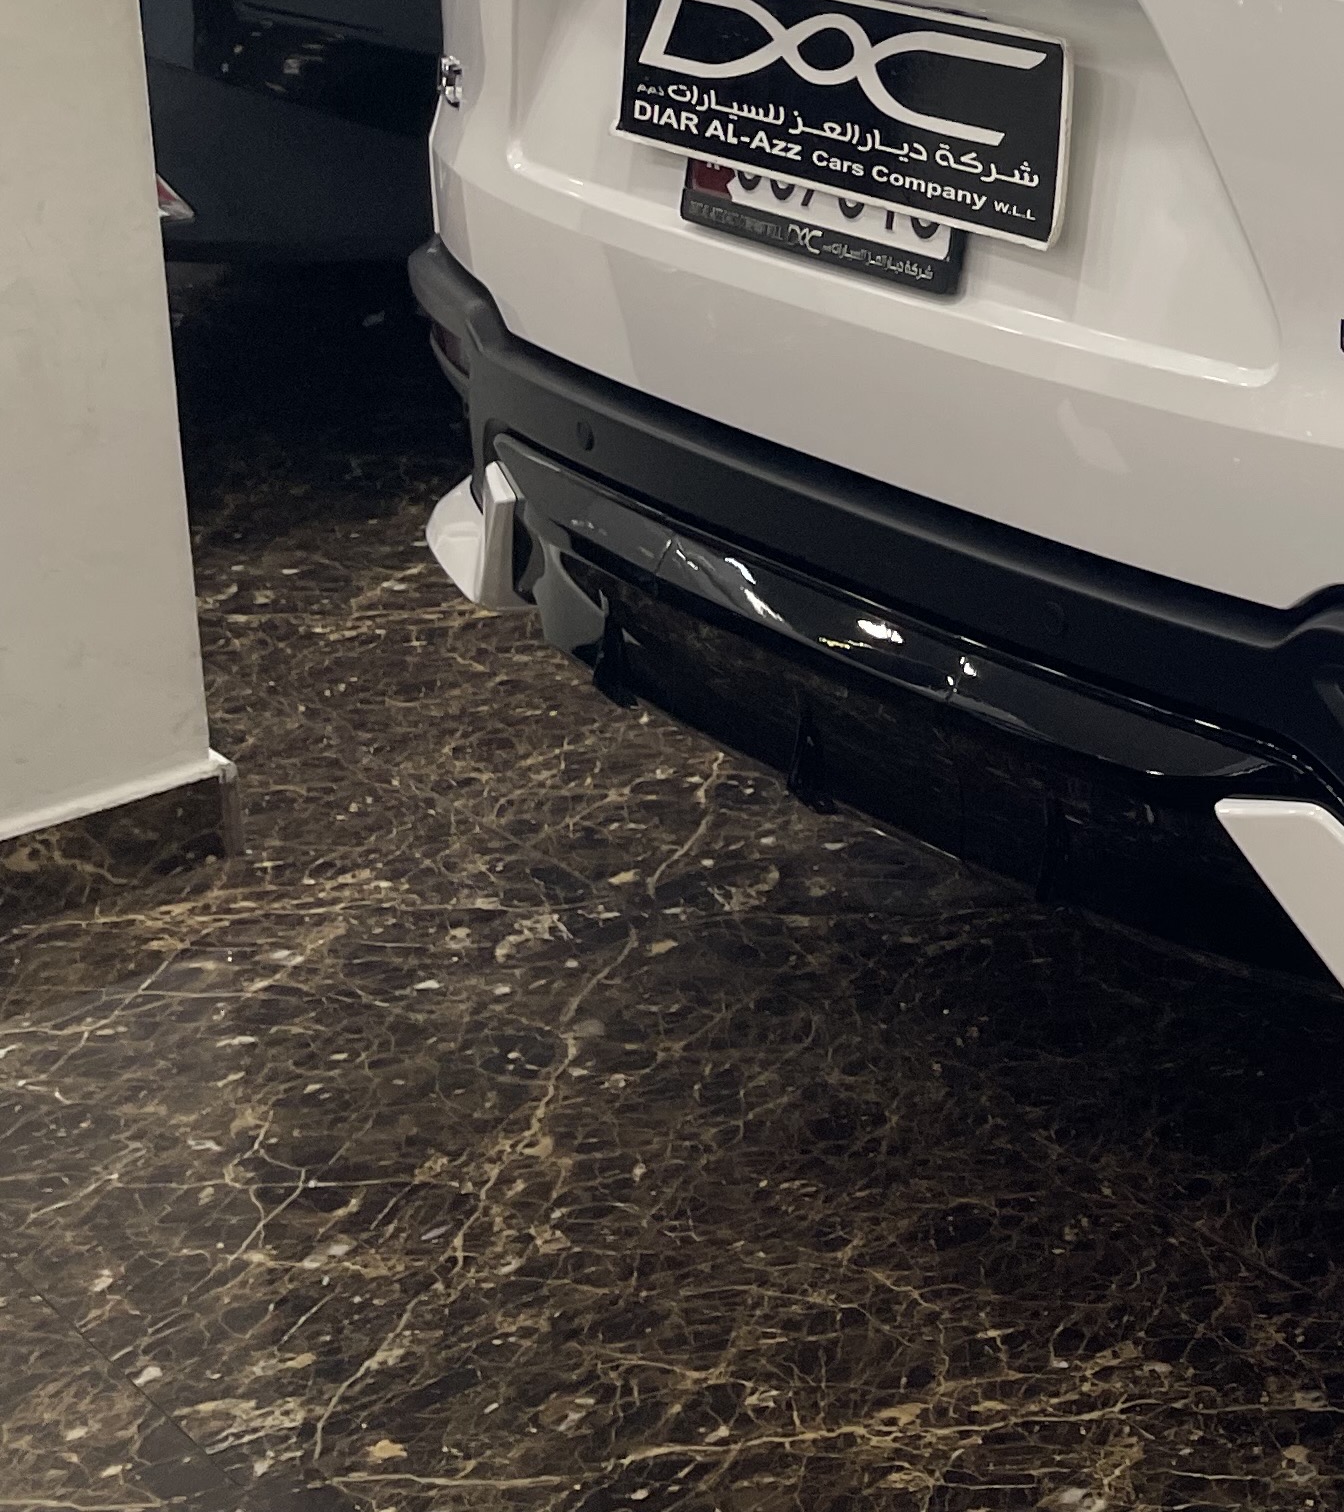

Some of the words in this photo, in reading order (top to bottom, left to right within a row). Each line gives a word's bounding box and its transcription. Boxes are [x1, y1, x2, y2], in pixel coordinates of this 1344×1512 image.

[667, 84, 786, 126] للسيارات
[633, 99, 699, 135] DIAR
[704, 118, 803, 161] AL-Azz
[811, 150, 865, 177] Cars
[871, 165, 988, 210] Company
[934, 142, 1041, 188] شركة
